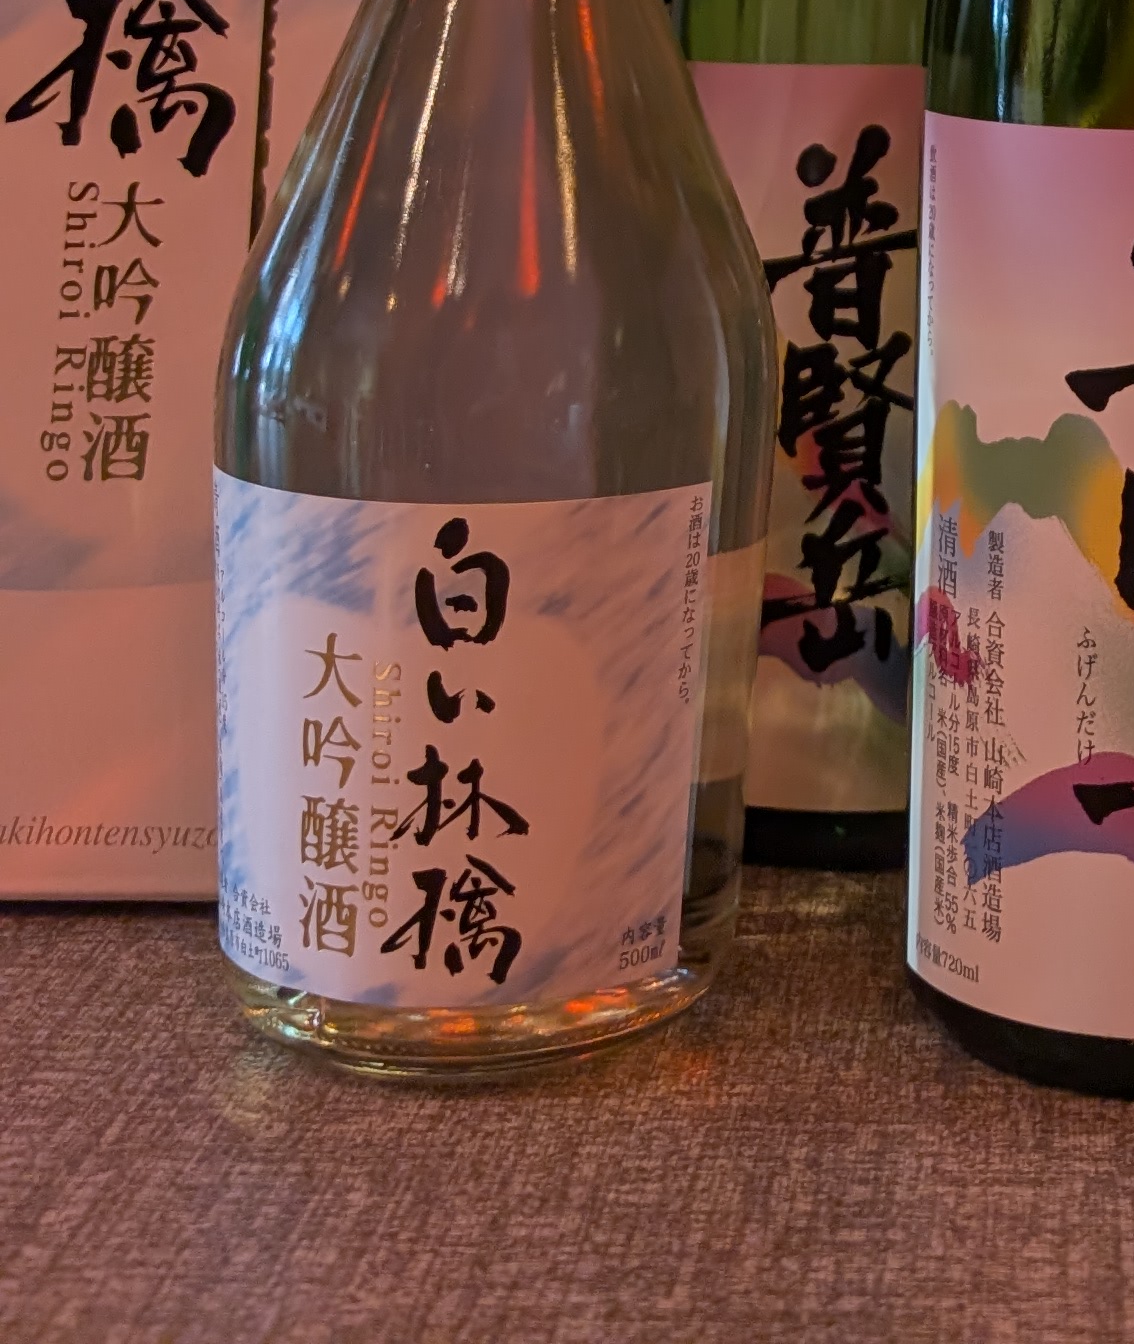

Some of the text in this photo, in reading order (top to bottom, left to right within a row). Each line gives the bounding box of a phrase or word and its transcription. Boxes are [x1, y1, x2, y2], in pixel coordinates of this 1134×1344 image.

[40, 180, 101, 483] Shiroi Ringo
[79, 180, 166, 482] 大吟醸酒
[677, 494, 704, 706] お酒は20歳になってから。
[938, 513, 959, 600] 清酒
[299, 632, 363, 959] 大吟醸酒
[361, 660, 402, 930] Shiroi Ringo
[1076, 626, 1099, 766] ふげんだけ
